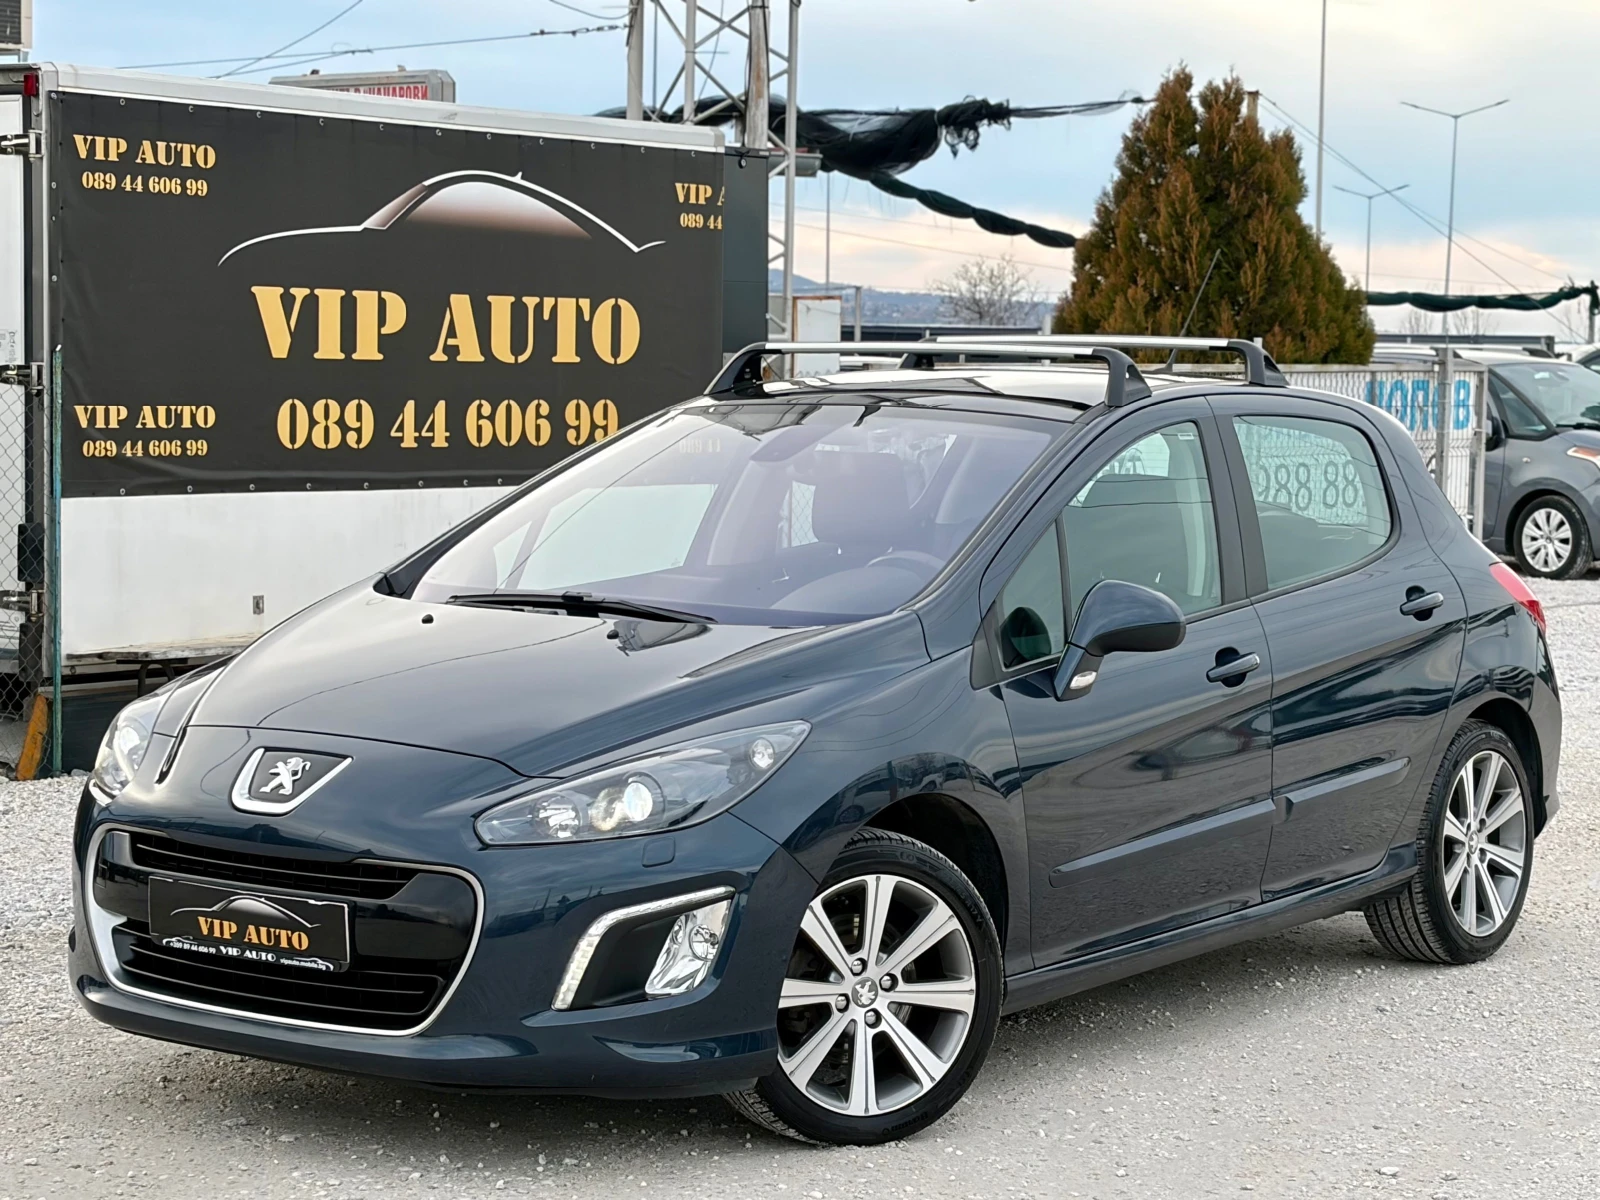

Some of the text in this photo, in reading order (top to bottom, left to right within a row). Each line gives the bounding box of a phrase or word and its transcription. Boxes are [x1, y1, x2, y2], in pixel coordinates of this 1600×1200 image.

[73, 134, 216, 169] VIP AUTO
[81, 171, 208, 196] 089 44 606 99
[674, 182, 713, 205] VIP
[680, 212, 723, 230] 089 44
[250, 285, 641, 365] VIP AUTO
[73, 405, 216, 429] VIP AUTO
[276, 398, 619, 449] 089 44 606 99
[82, 439, 208, 457] 089 44 606 99
[197, 916, 310, 951] VIP AUTO
[219, 945, 241, 956] VIP
[243, 950, 277, 962] AUTO
